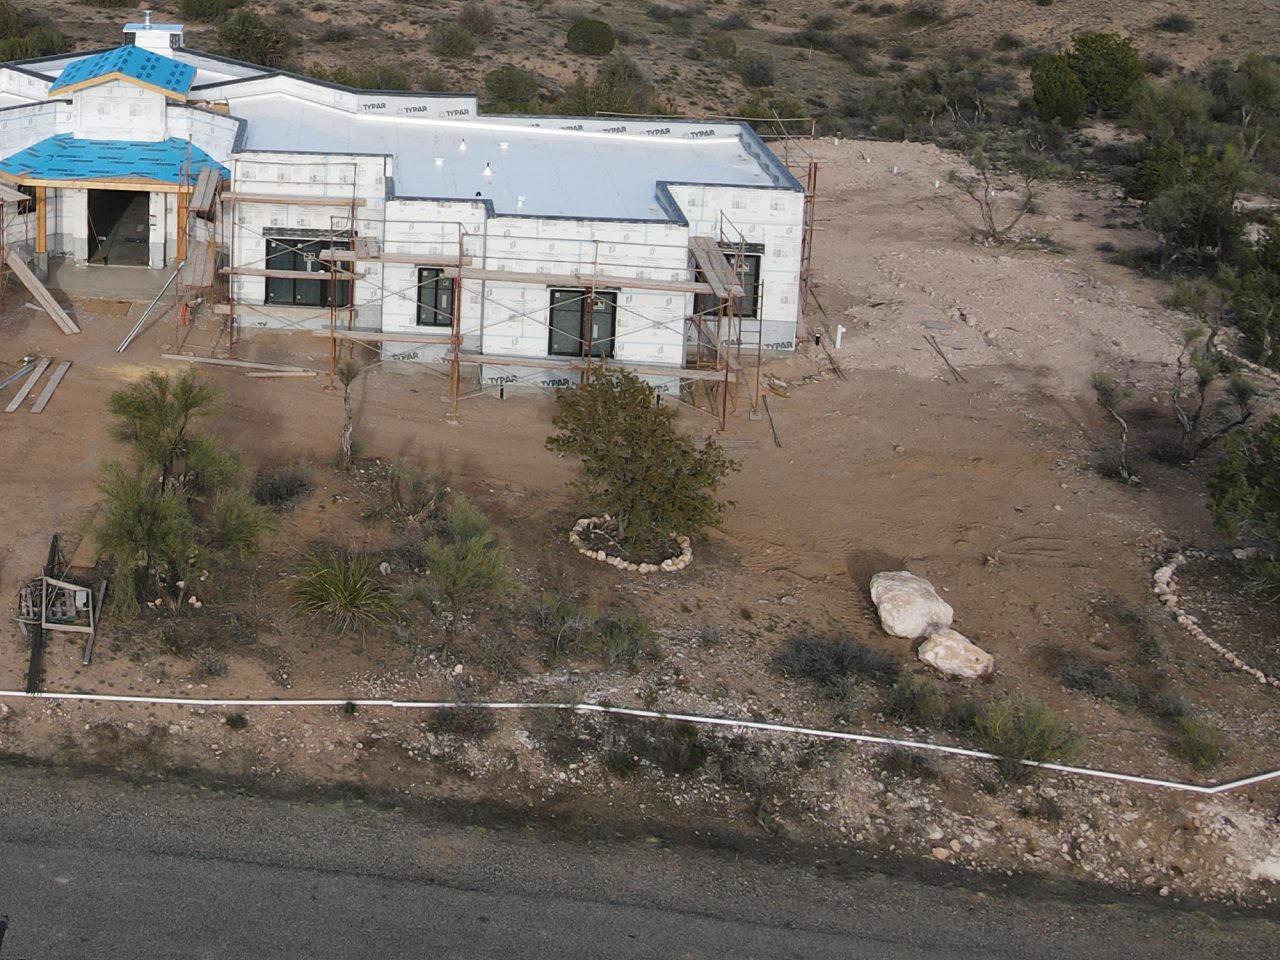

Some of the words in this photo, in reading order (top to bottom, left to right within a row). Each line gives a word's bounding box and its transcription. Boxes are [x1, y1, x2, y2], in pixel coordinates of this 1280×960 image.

[363, 102, 386, 111] TYPAR
[404, 105, 427, 113] TYPAR
[445, 109, 469, 117] TYPAR
[646, 128, 671, 136] TYPAR
[690, 129, 716, 139] TYPAR
[764, 341, 793, 350] TYPAR
[488, 375, 517, 384] TYPAR
[541, 378, 570, 386] TYPAR
